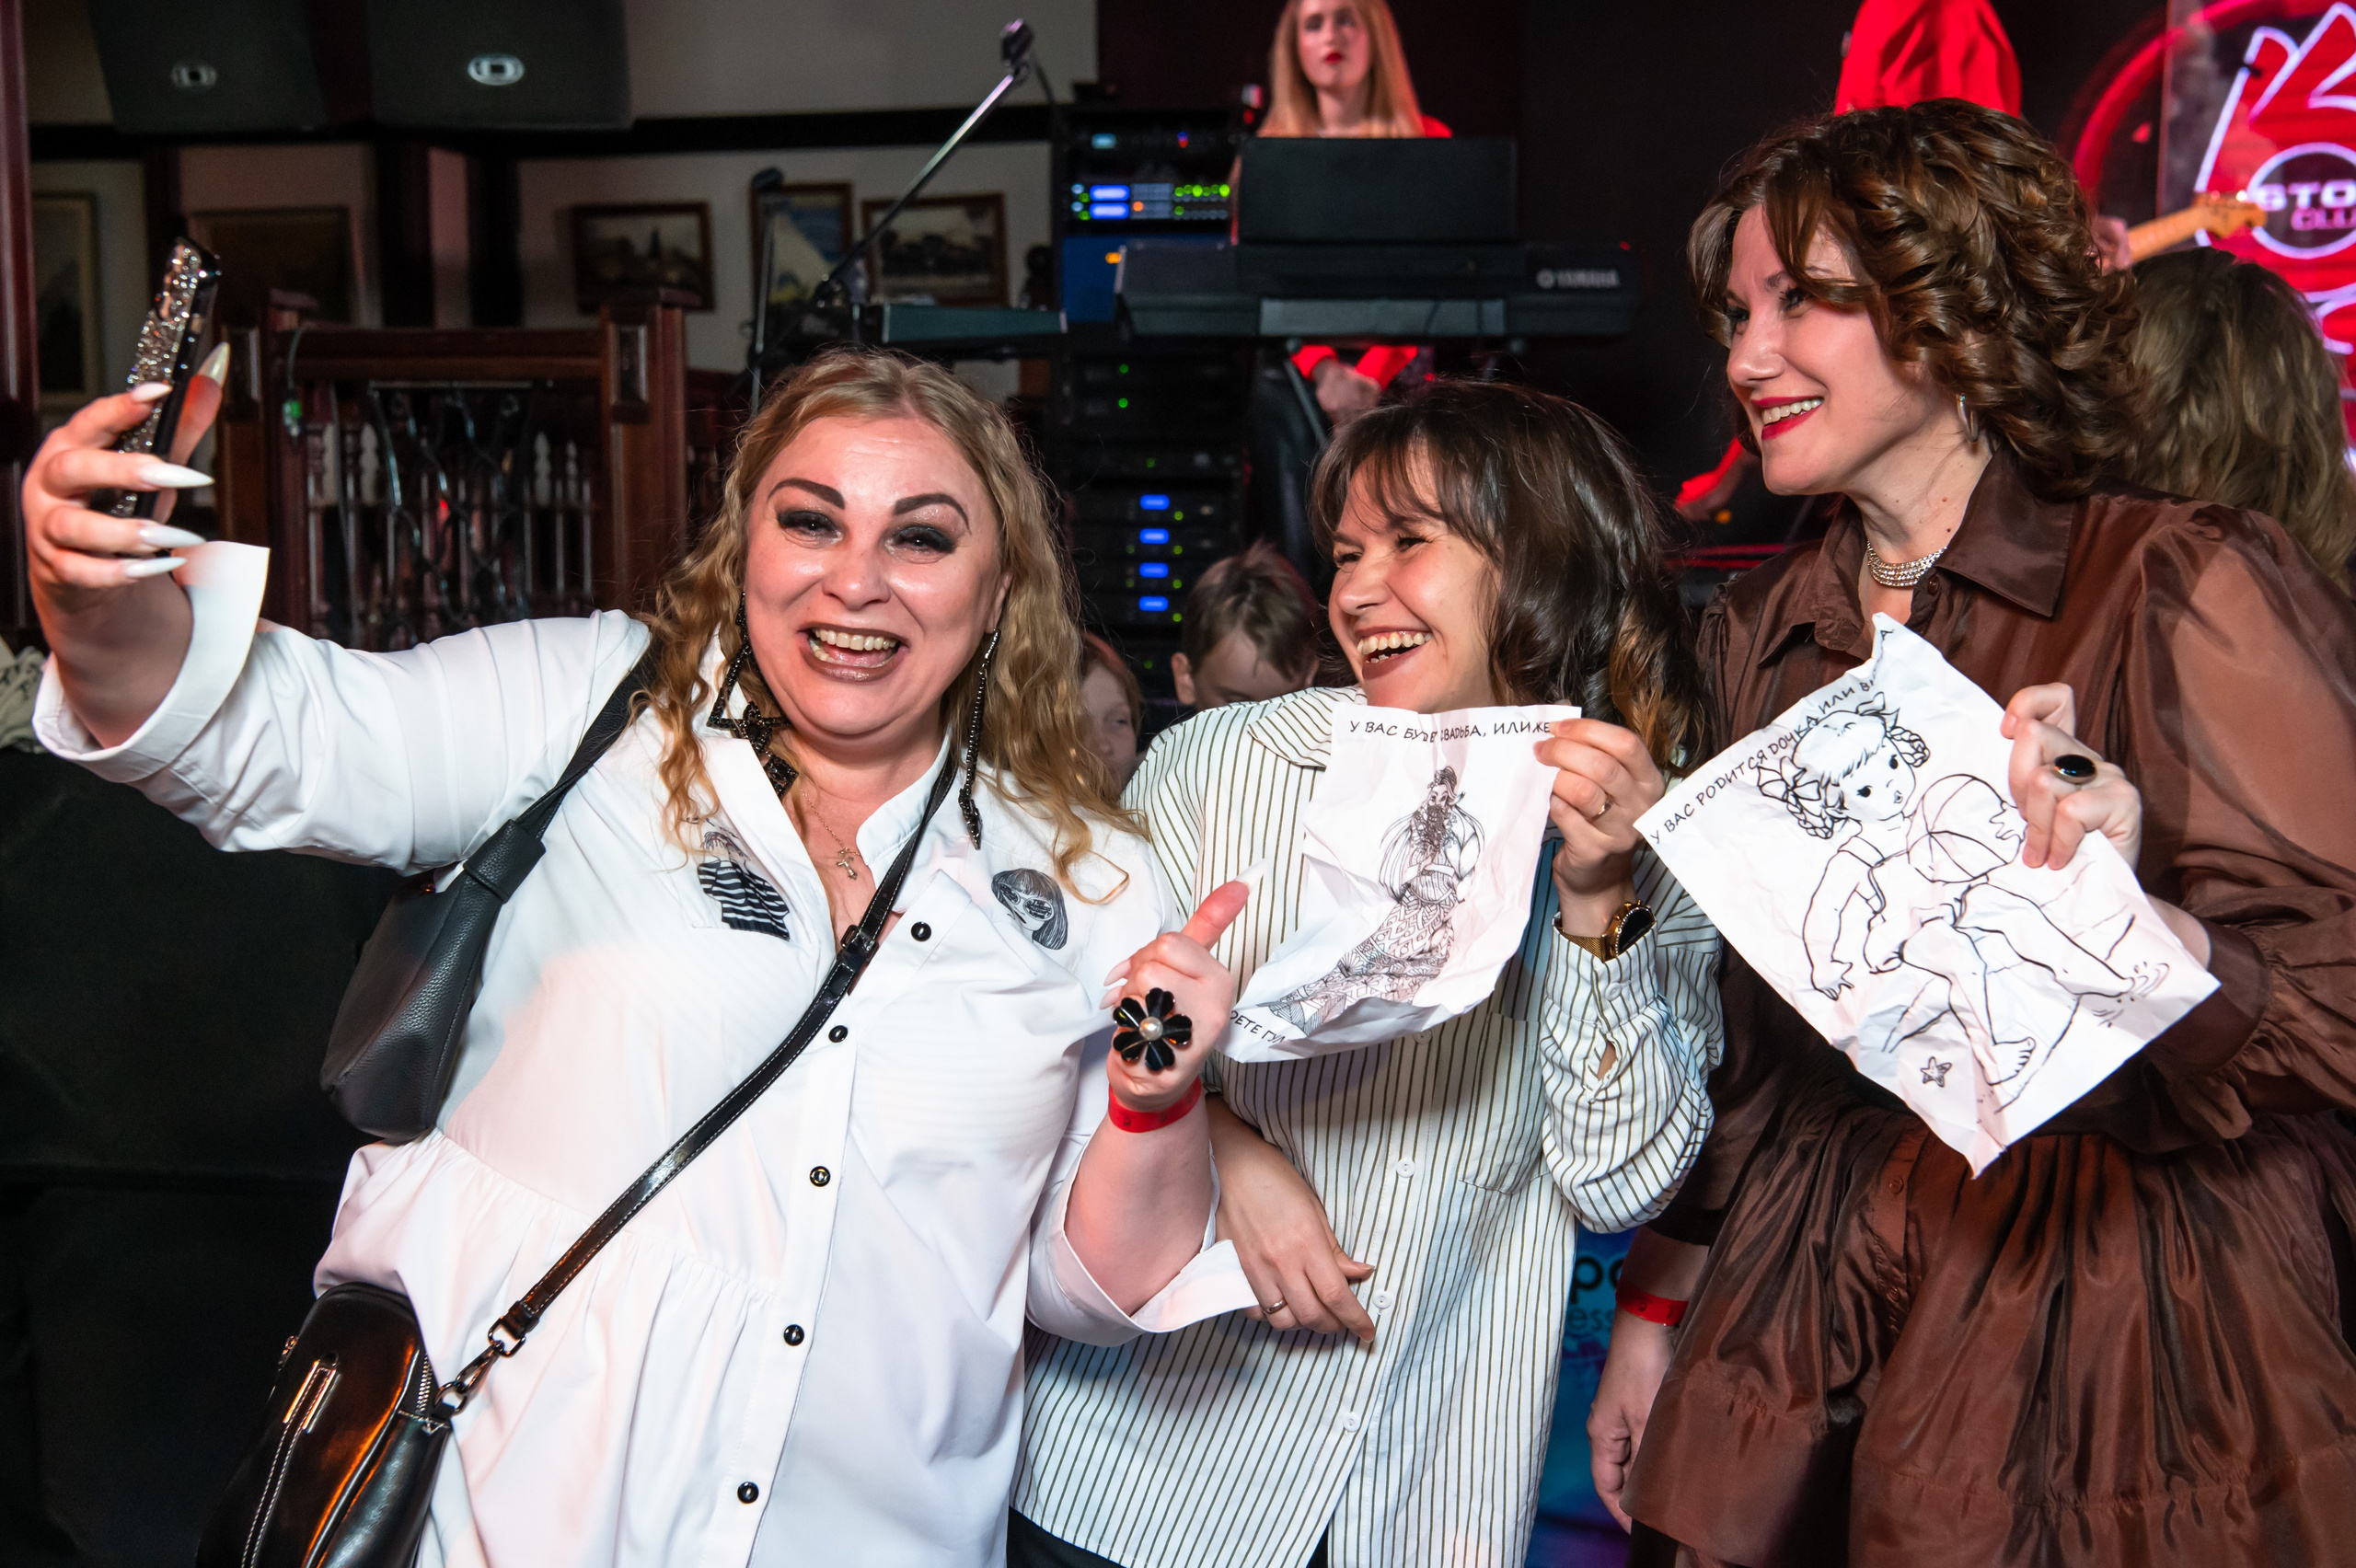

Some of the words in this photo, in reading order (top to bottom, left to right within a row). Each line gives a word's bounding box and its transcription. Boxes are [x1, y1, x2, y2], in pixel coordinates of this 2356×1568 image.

[1350, 721, 1360, 732] У
[1365, 721, 1398, 736] ВАС
[1651, 830, 1660, 844] У
[1663, 803, 1695, 833] ВАС
[1695, 750, 1767, 806] РОДИТСЯ
[1819, 686, 1855, 714] ИЛИ
